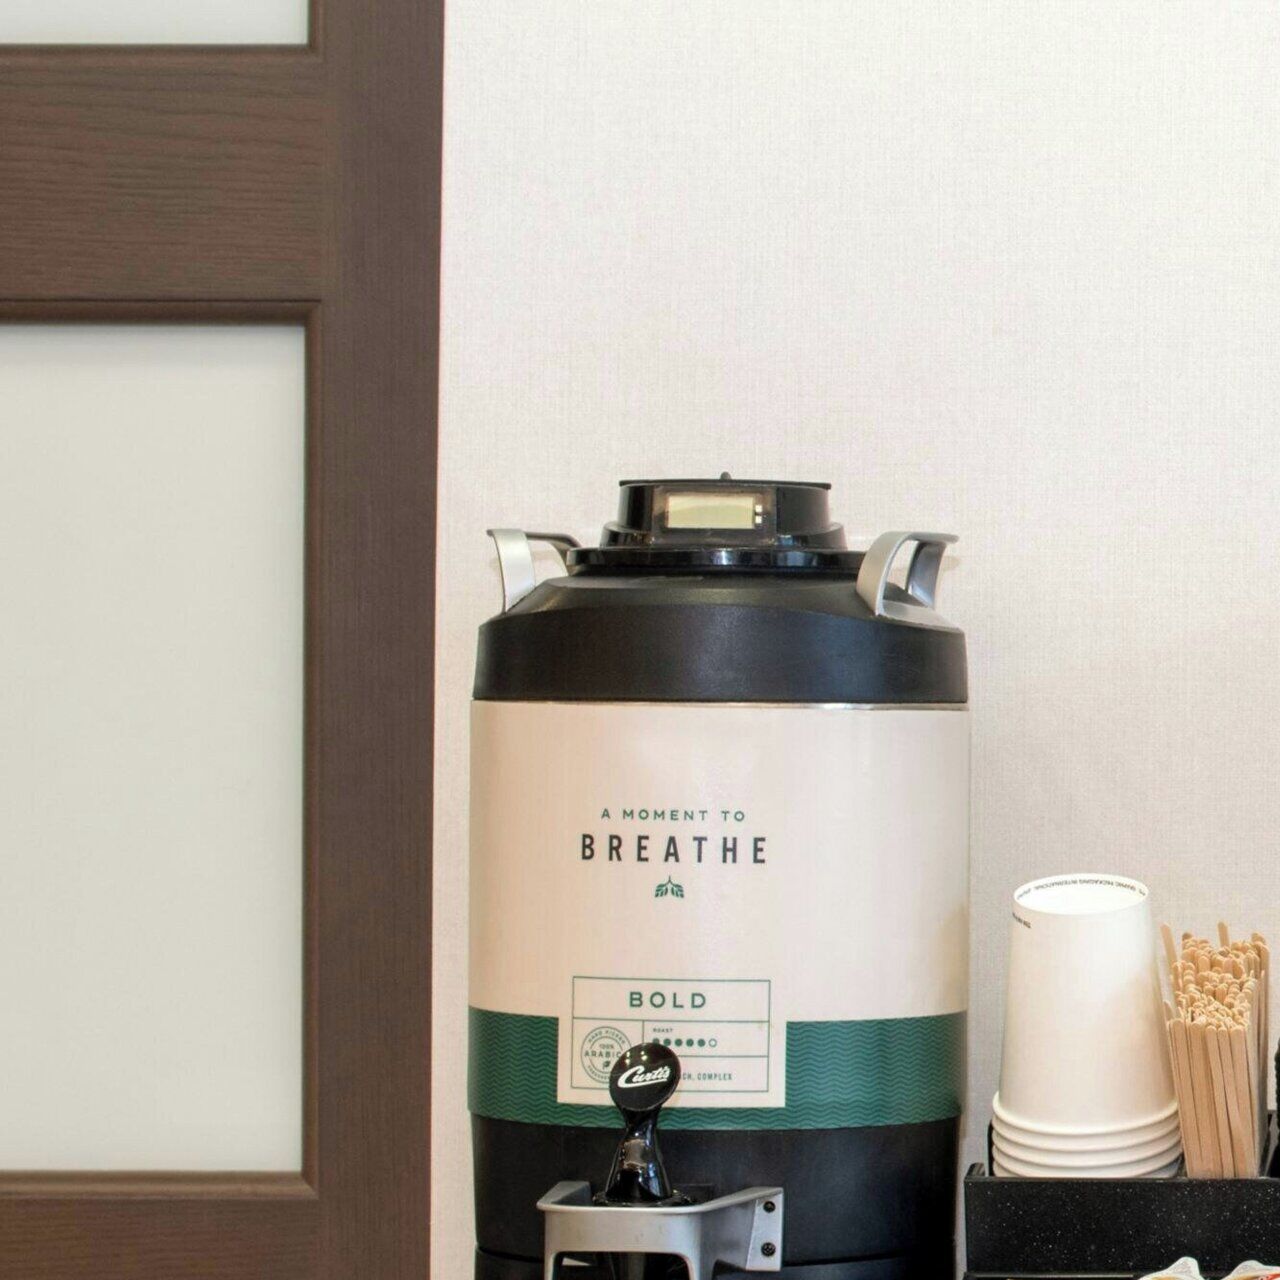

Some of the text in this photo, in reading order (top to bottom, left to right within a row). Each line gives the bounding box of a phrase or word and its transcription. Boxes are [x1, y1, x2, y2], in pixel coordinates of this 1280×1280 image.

[600, 807, 746, 822] A MOMENT TO
[581, 833, 767, 865] BREATHE
[629, 991, 706, 1008] BOLD
[584, 1050, 621, 1058] ARABIC
[617, 1065, 672, 1088] Curtis
[697, 1073, 732, 1081] COMPLEX
